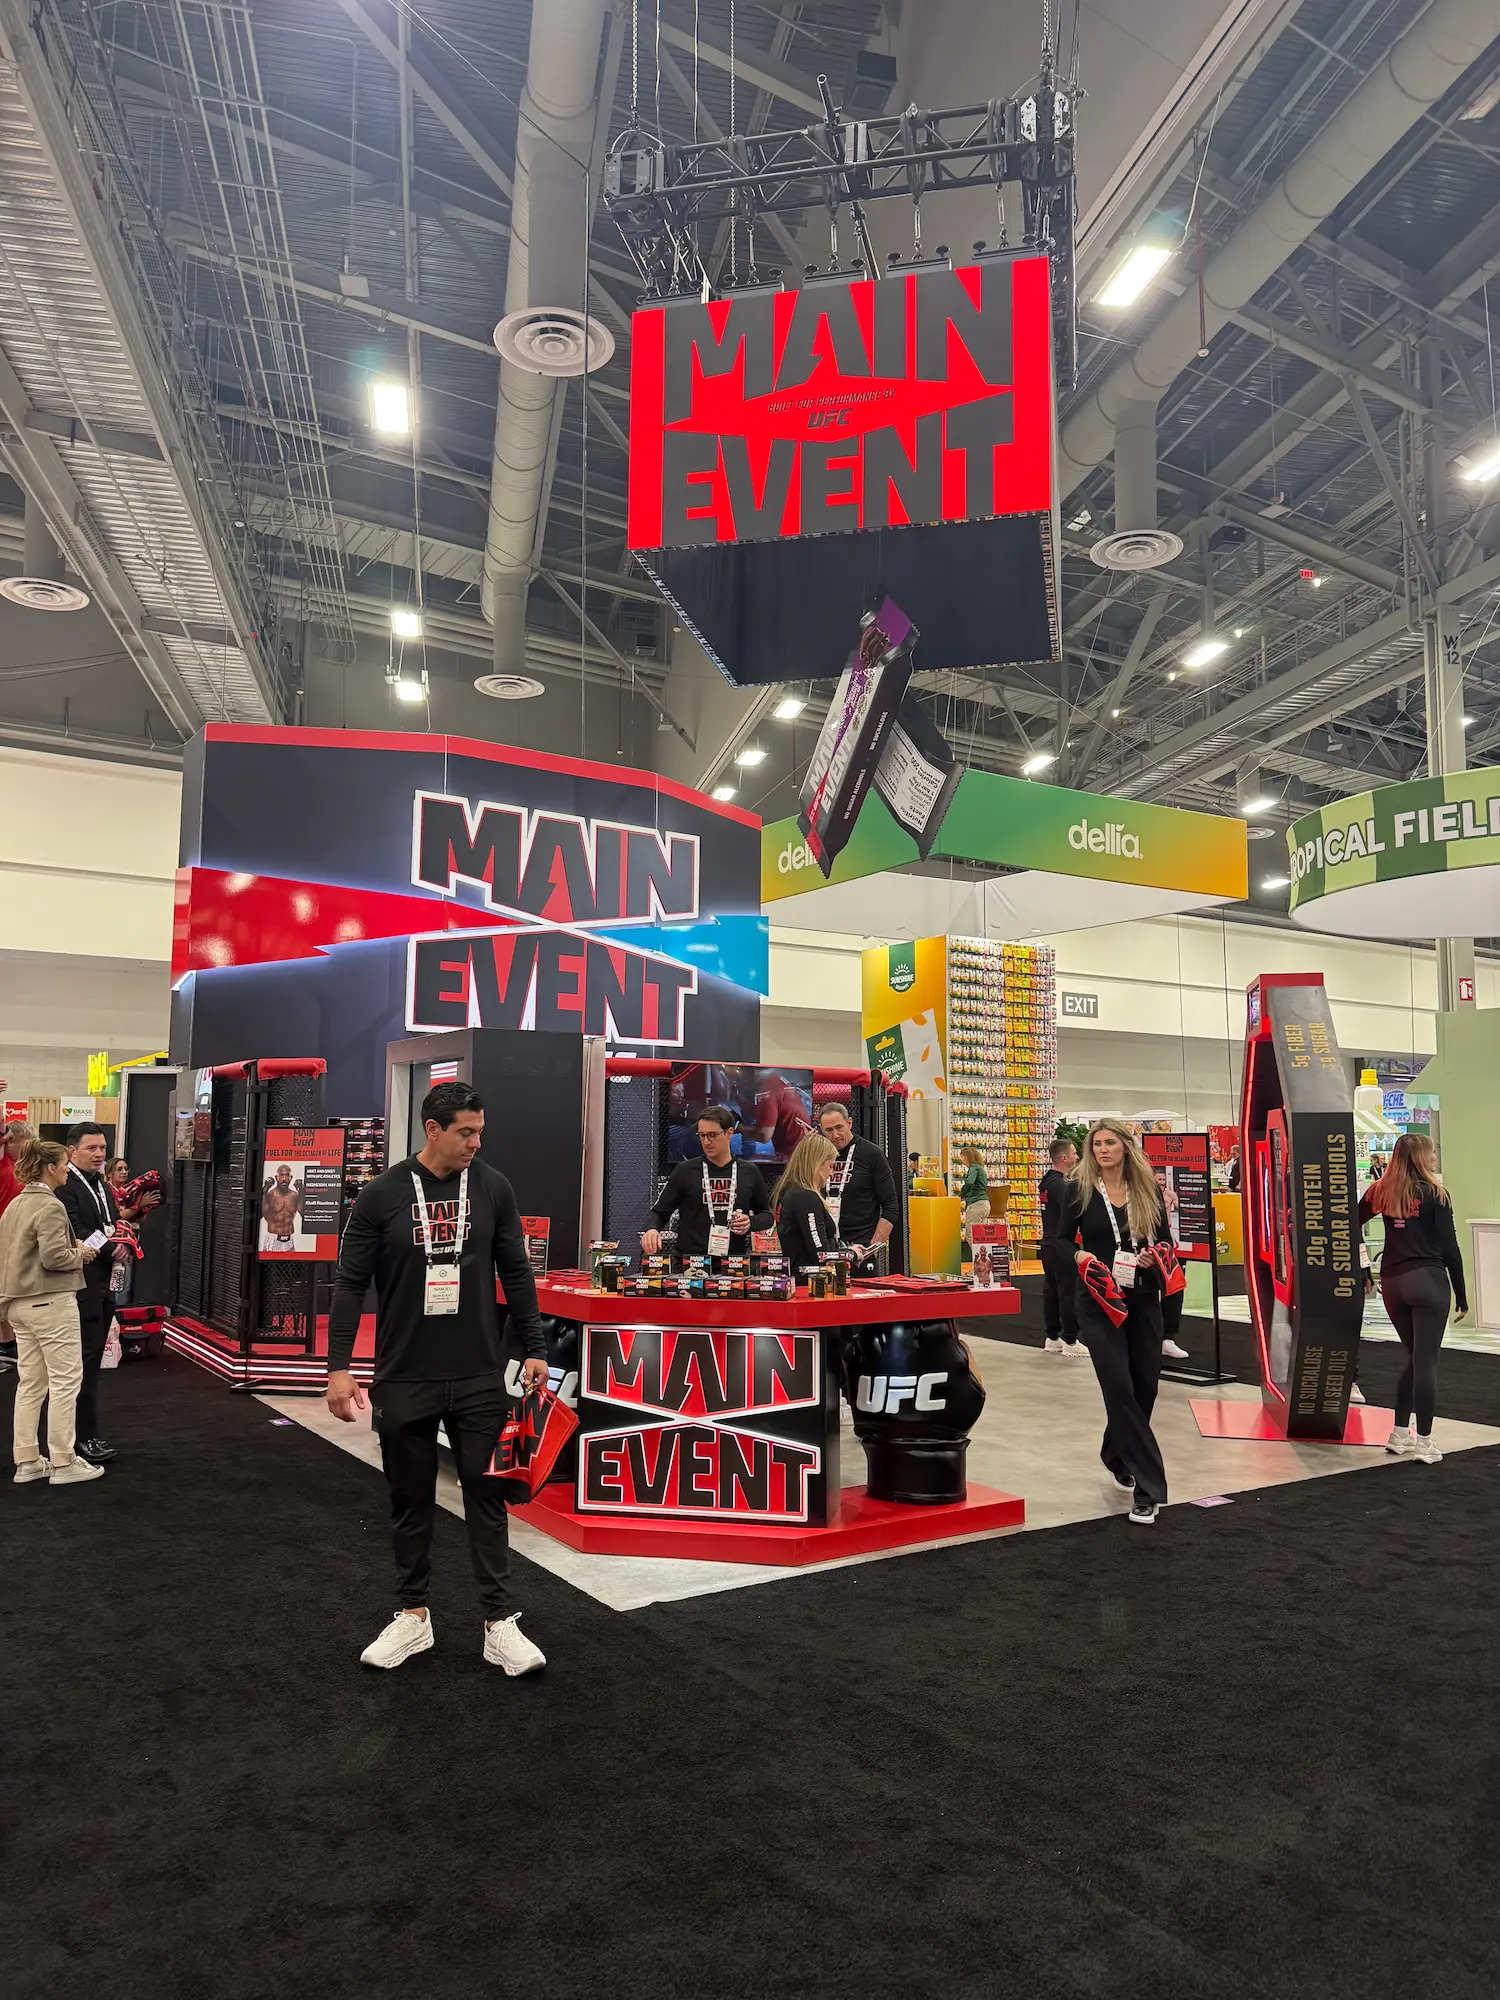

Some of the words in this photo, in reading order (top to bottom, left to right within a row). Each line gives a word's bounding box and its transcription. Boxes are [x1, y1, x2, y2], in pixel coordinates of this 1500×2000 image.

[664, 262, 1014, 424] MAIN
[768, 401, 792, 412] BUILT
[797, 399, 813, 408] FOR
[816, 391, 881, 407] PERFORMANCE
[883, 388, 896, 399] BY
[807, 408, 852, 429] UFC
[662, 391, 1014, 546] EVENT
[1444, 635, 1459, 649] W
[1445, 651, 1460, 664] 12
[412, 790, 699, 924] MAIN
[778, 841, 818, 873] dell
[1290, 819, 1385, 885] ROPICAL
[407, 928, 698, 1044] EVENT
[890, 973, 914, 985] SUNSHINE
[1065, 996, 1096, 1014] EXIT
[1284, 1024, 1306, 1052] FIBER
[1308, 1022, 1330, 1054] SUGAR
[1291, 1055, 1310, 1068] 5g
[292, 1139, 315, 1147] EVENT
[293, 1129, 315, 1138] MAIN
[1165, 1136, 1183, 1145] MAIN
[266, 1149, 280, 1157] FUEL
[328, 1149, 341, 1157] LIFE
[1327, 1133, 1349, 1215] ALCOHOLS
[1303, 1164, 1324, 1230] PROTEIN
[1306, 1236, 1328, 1266] 20g
[1331, 1219, 1351, 1272] SUGAR
[1334, 1277, 1356, 1298] 0g
[585, 1328, 818, 1415] MAIN
[1300, 1346, 1324, 1400] SUCRALOSE
[1328, 1350, 1348, 1372] OILS
[856, 1372, 948, 1414] UFC
[1324, 1375, 1344, 1398] SEED
[1298, 1402, 1315, 1415] NO
[1322, 1400, 1340, 1413] NO
[505, 1424, 520, 1434] UFC
[582, 1426, 819, 1517] EVENT
